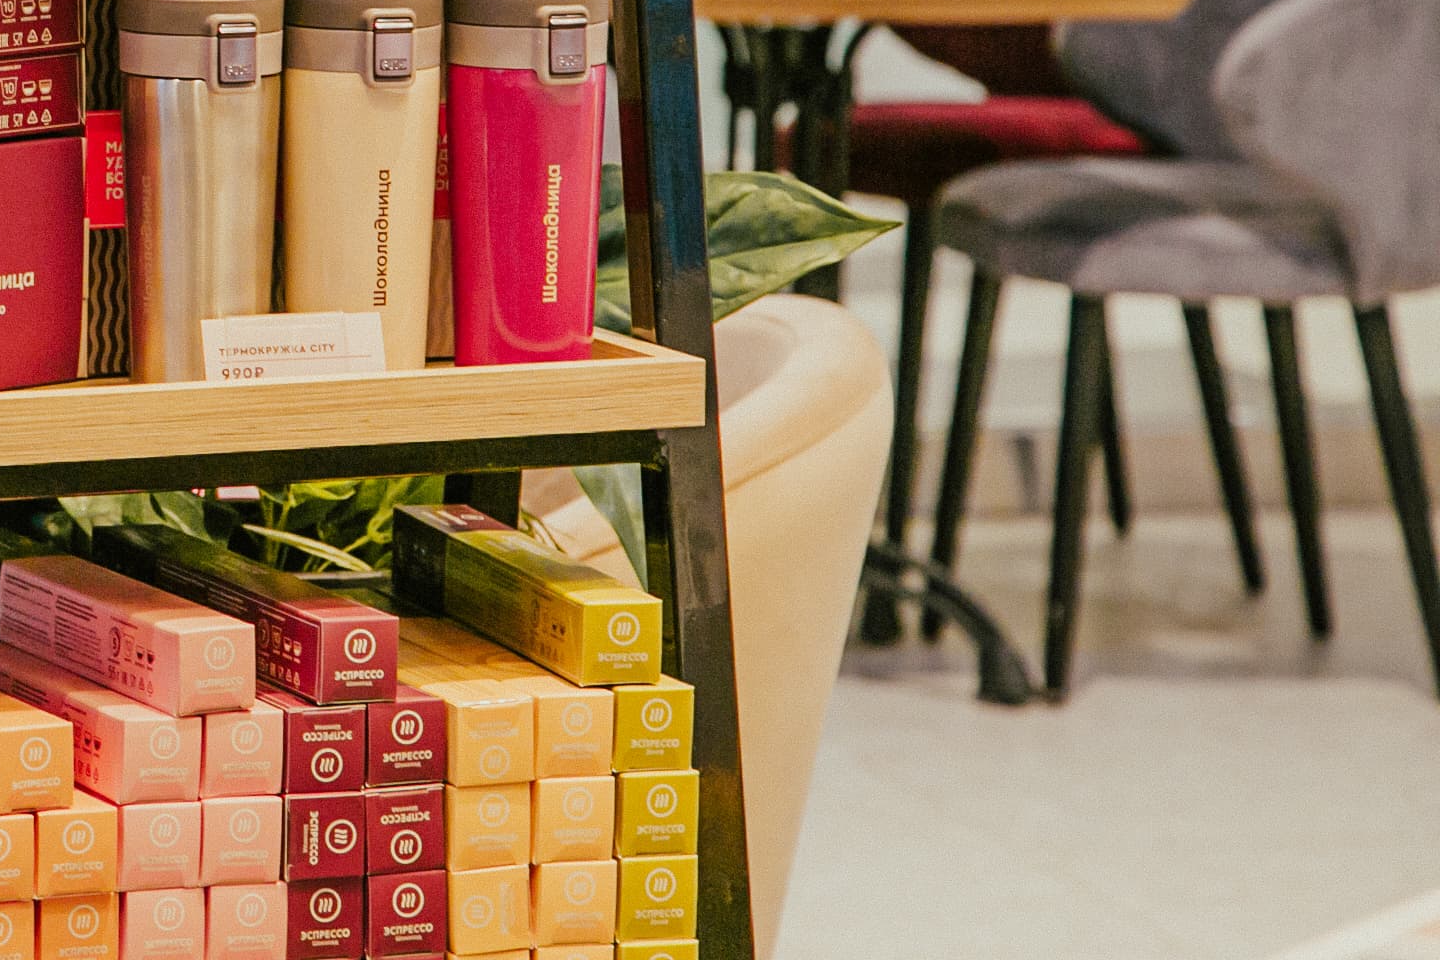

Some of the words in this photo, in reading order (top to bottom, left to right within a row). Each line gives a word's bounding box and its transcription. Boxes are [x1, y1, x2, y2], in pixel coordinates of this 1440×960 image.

[3, 0, 14, 13] 10
[4, 81, 15, 94] 10
[373, 169, 391, 306] Шоколадница
[543, 164, 563, 303] Шоколадница
[310, 343, 335, 353] CITY
[334, 669, 385, 681] ЭСПРЕССО
[303, 731, 353, 742] ЭСПРЕССО
[382, 749, 432, 763] ЭСПРЕССО
[380, 811, 431, 825] ЭСПРЕССО
[309, 811, 319, 865] ЭСПРЕССО
[300, 928, 351, 941] ЭСПРЕССО
[383, 922, 434, 937] ЭСПРЕССО
